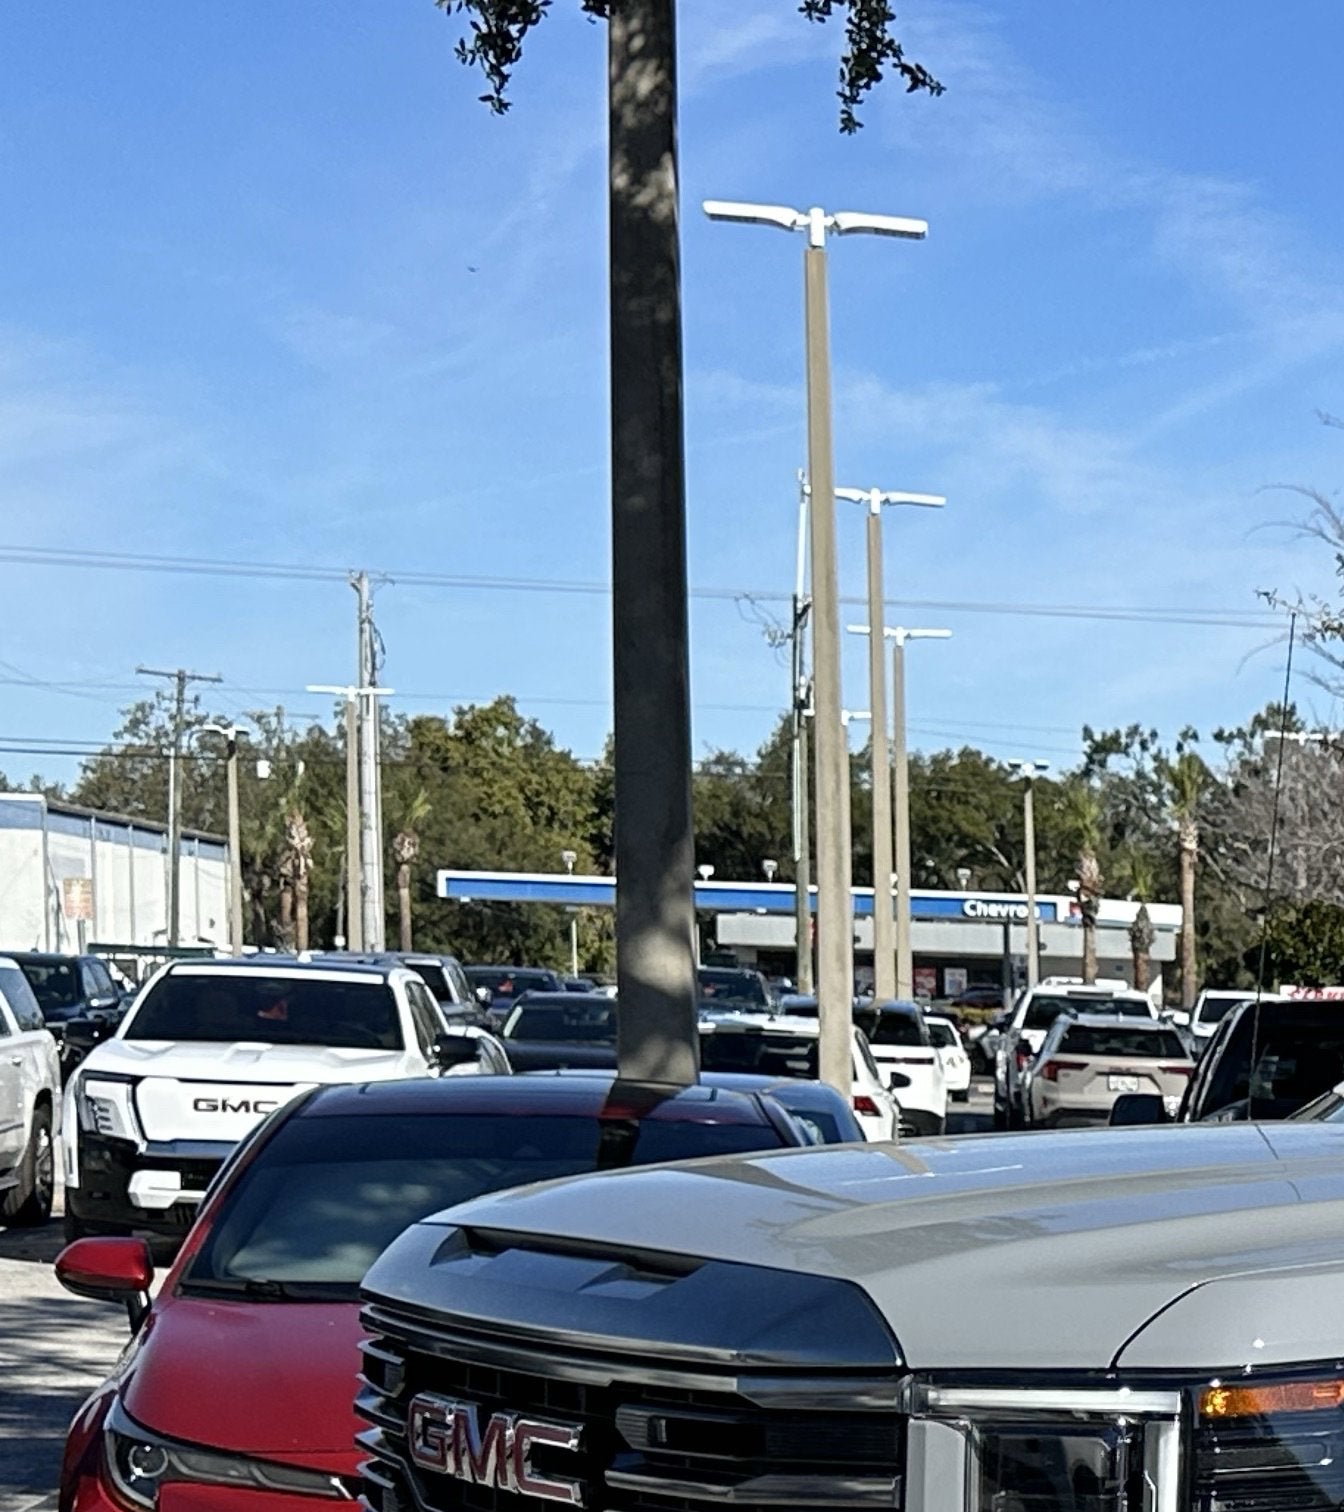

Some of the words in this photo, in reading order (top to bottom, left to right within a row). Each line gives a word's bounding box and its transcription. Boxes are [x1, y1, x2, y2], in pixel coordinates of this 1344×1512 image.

[963, 899, 1041, 919] Chevron
[193, 1098, 279, 1114] GMC
[408, 1393, 585, 1508] GMC
